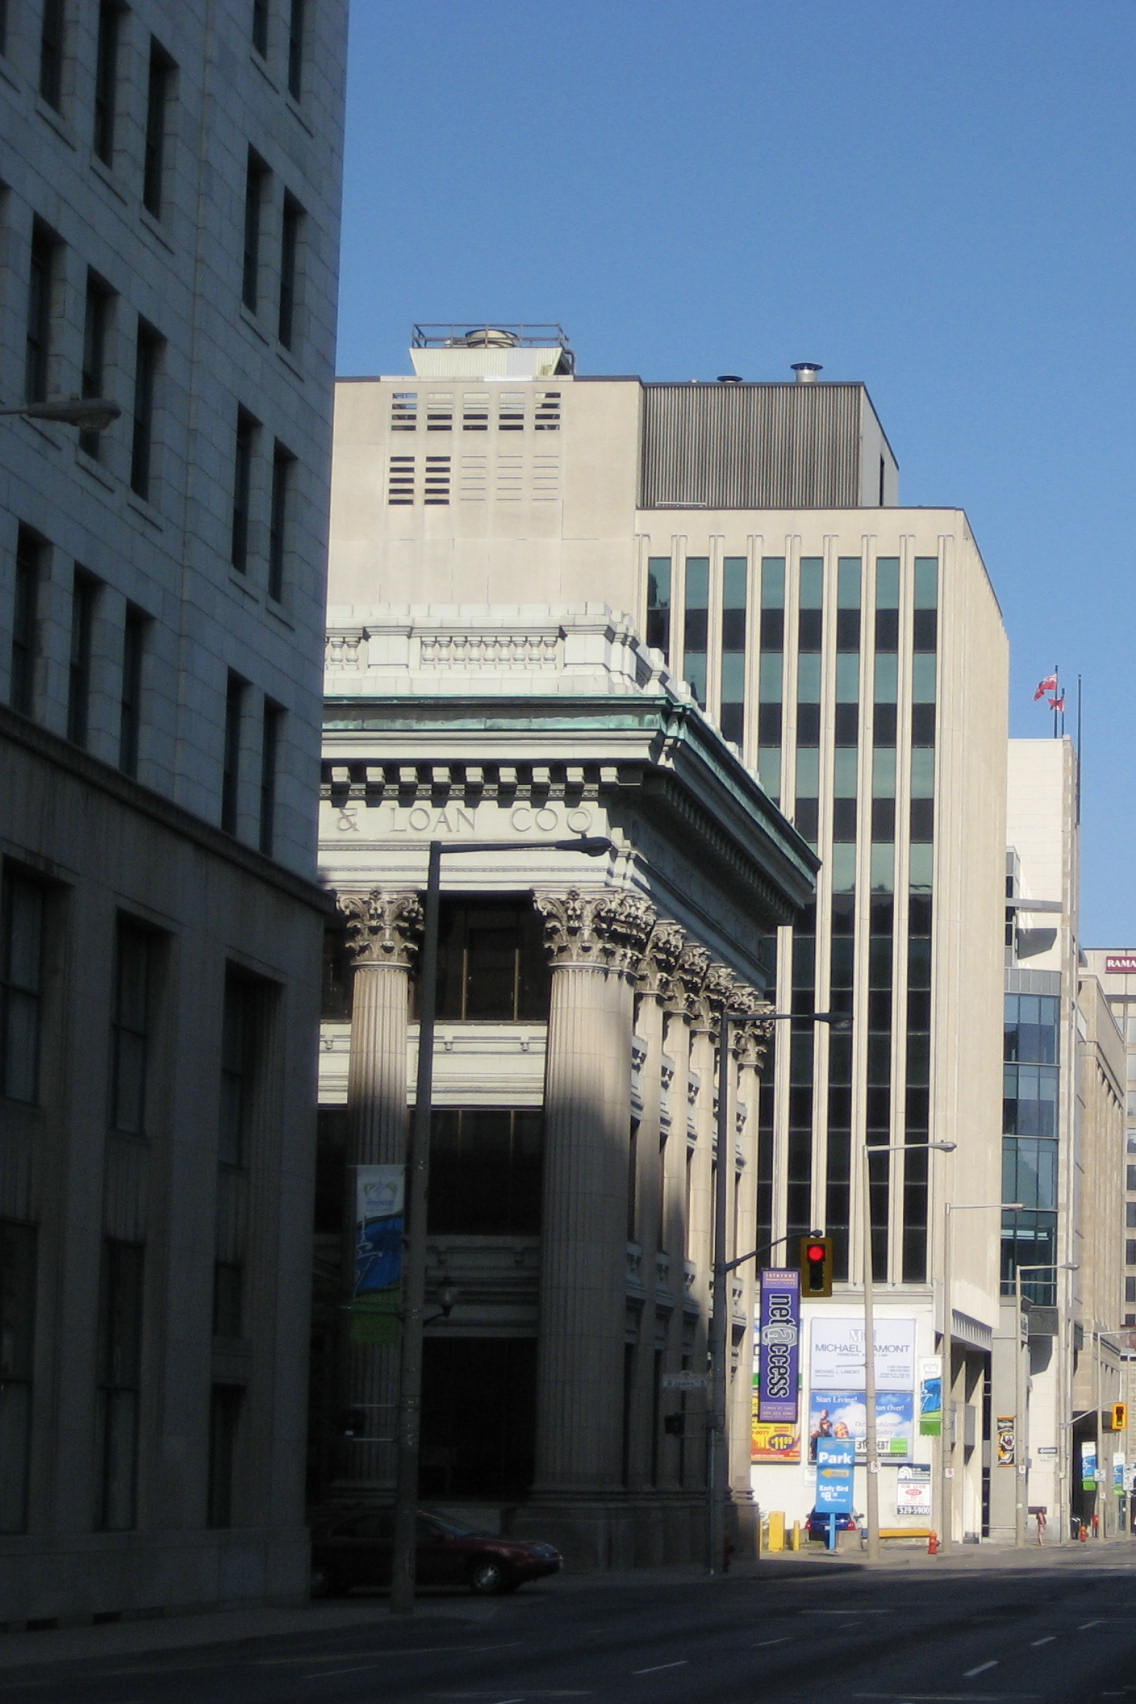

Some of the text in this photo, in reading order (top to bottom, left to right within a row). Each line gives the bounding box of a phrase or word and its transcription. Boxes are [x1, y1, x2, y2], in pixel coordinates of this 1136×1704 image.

[336, 807, 359, 832] &
[389, 807, 477, 833] LOAN
[815, 1344, 910, 1353] MICHAEL AMONT
[818, 1452, 852, 1464] Park
